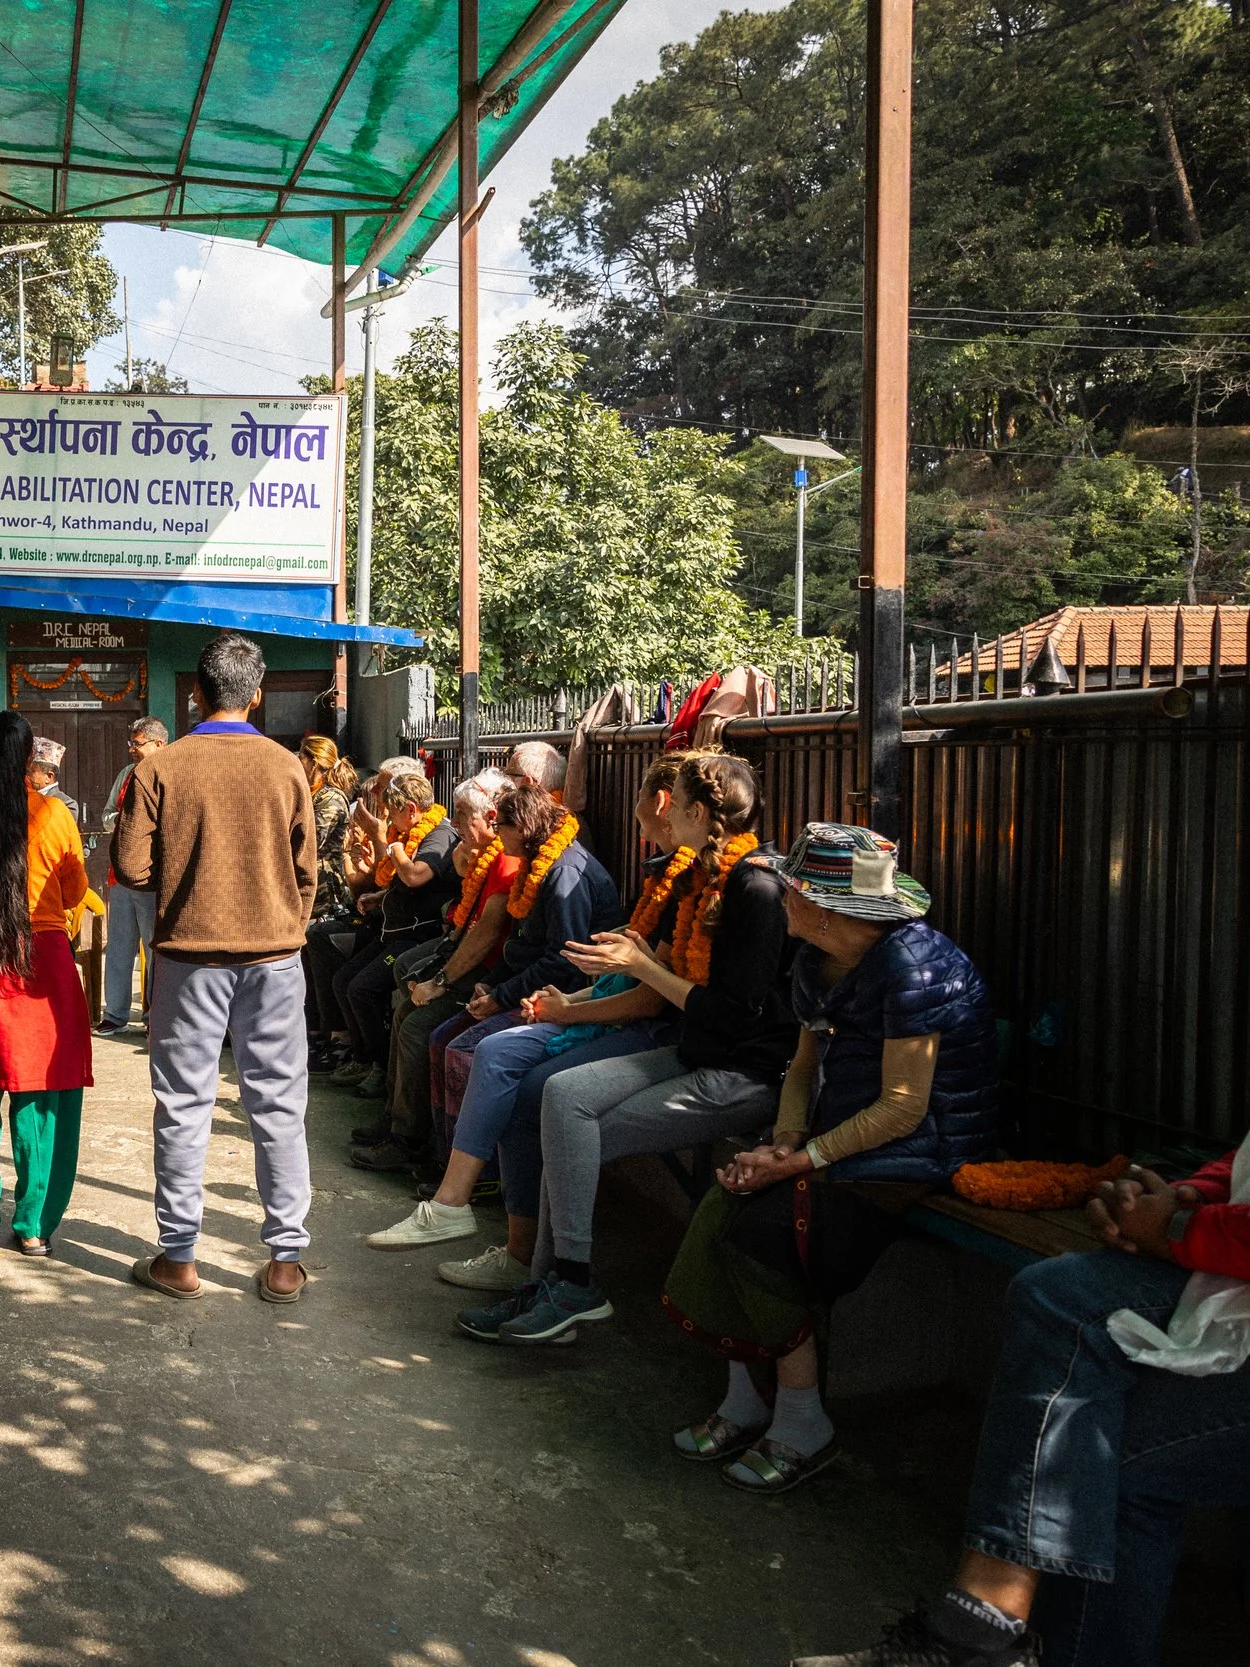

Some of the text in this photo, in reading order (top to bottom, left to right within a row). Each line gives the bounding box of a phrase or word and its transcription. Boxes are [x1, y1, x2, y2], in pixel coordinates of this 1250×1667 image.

[131, 409, 216, 463] केन्द्र,
[231, 411, 329, 462] नेपाल
[147, 479, 240, 512] CENTER,
[249, 482, 320, 509] NEPAL
[62, 515, 157, 534] Kathmandu,
[162, 518, 209, 535] Nepal
[9, 548, 47, 562] Website
[165, 552, 201, 567] E-mail:
[203, 553, 328, 571] infodrcnepal@gmail.com
[78, 622, 111, 636] NEPAL
[55, 636, 125, 649] MEDICAL-ROOM
